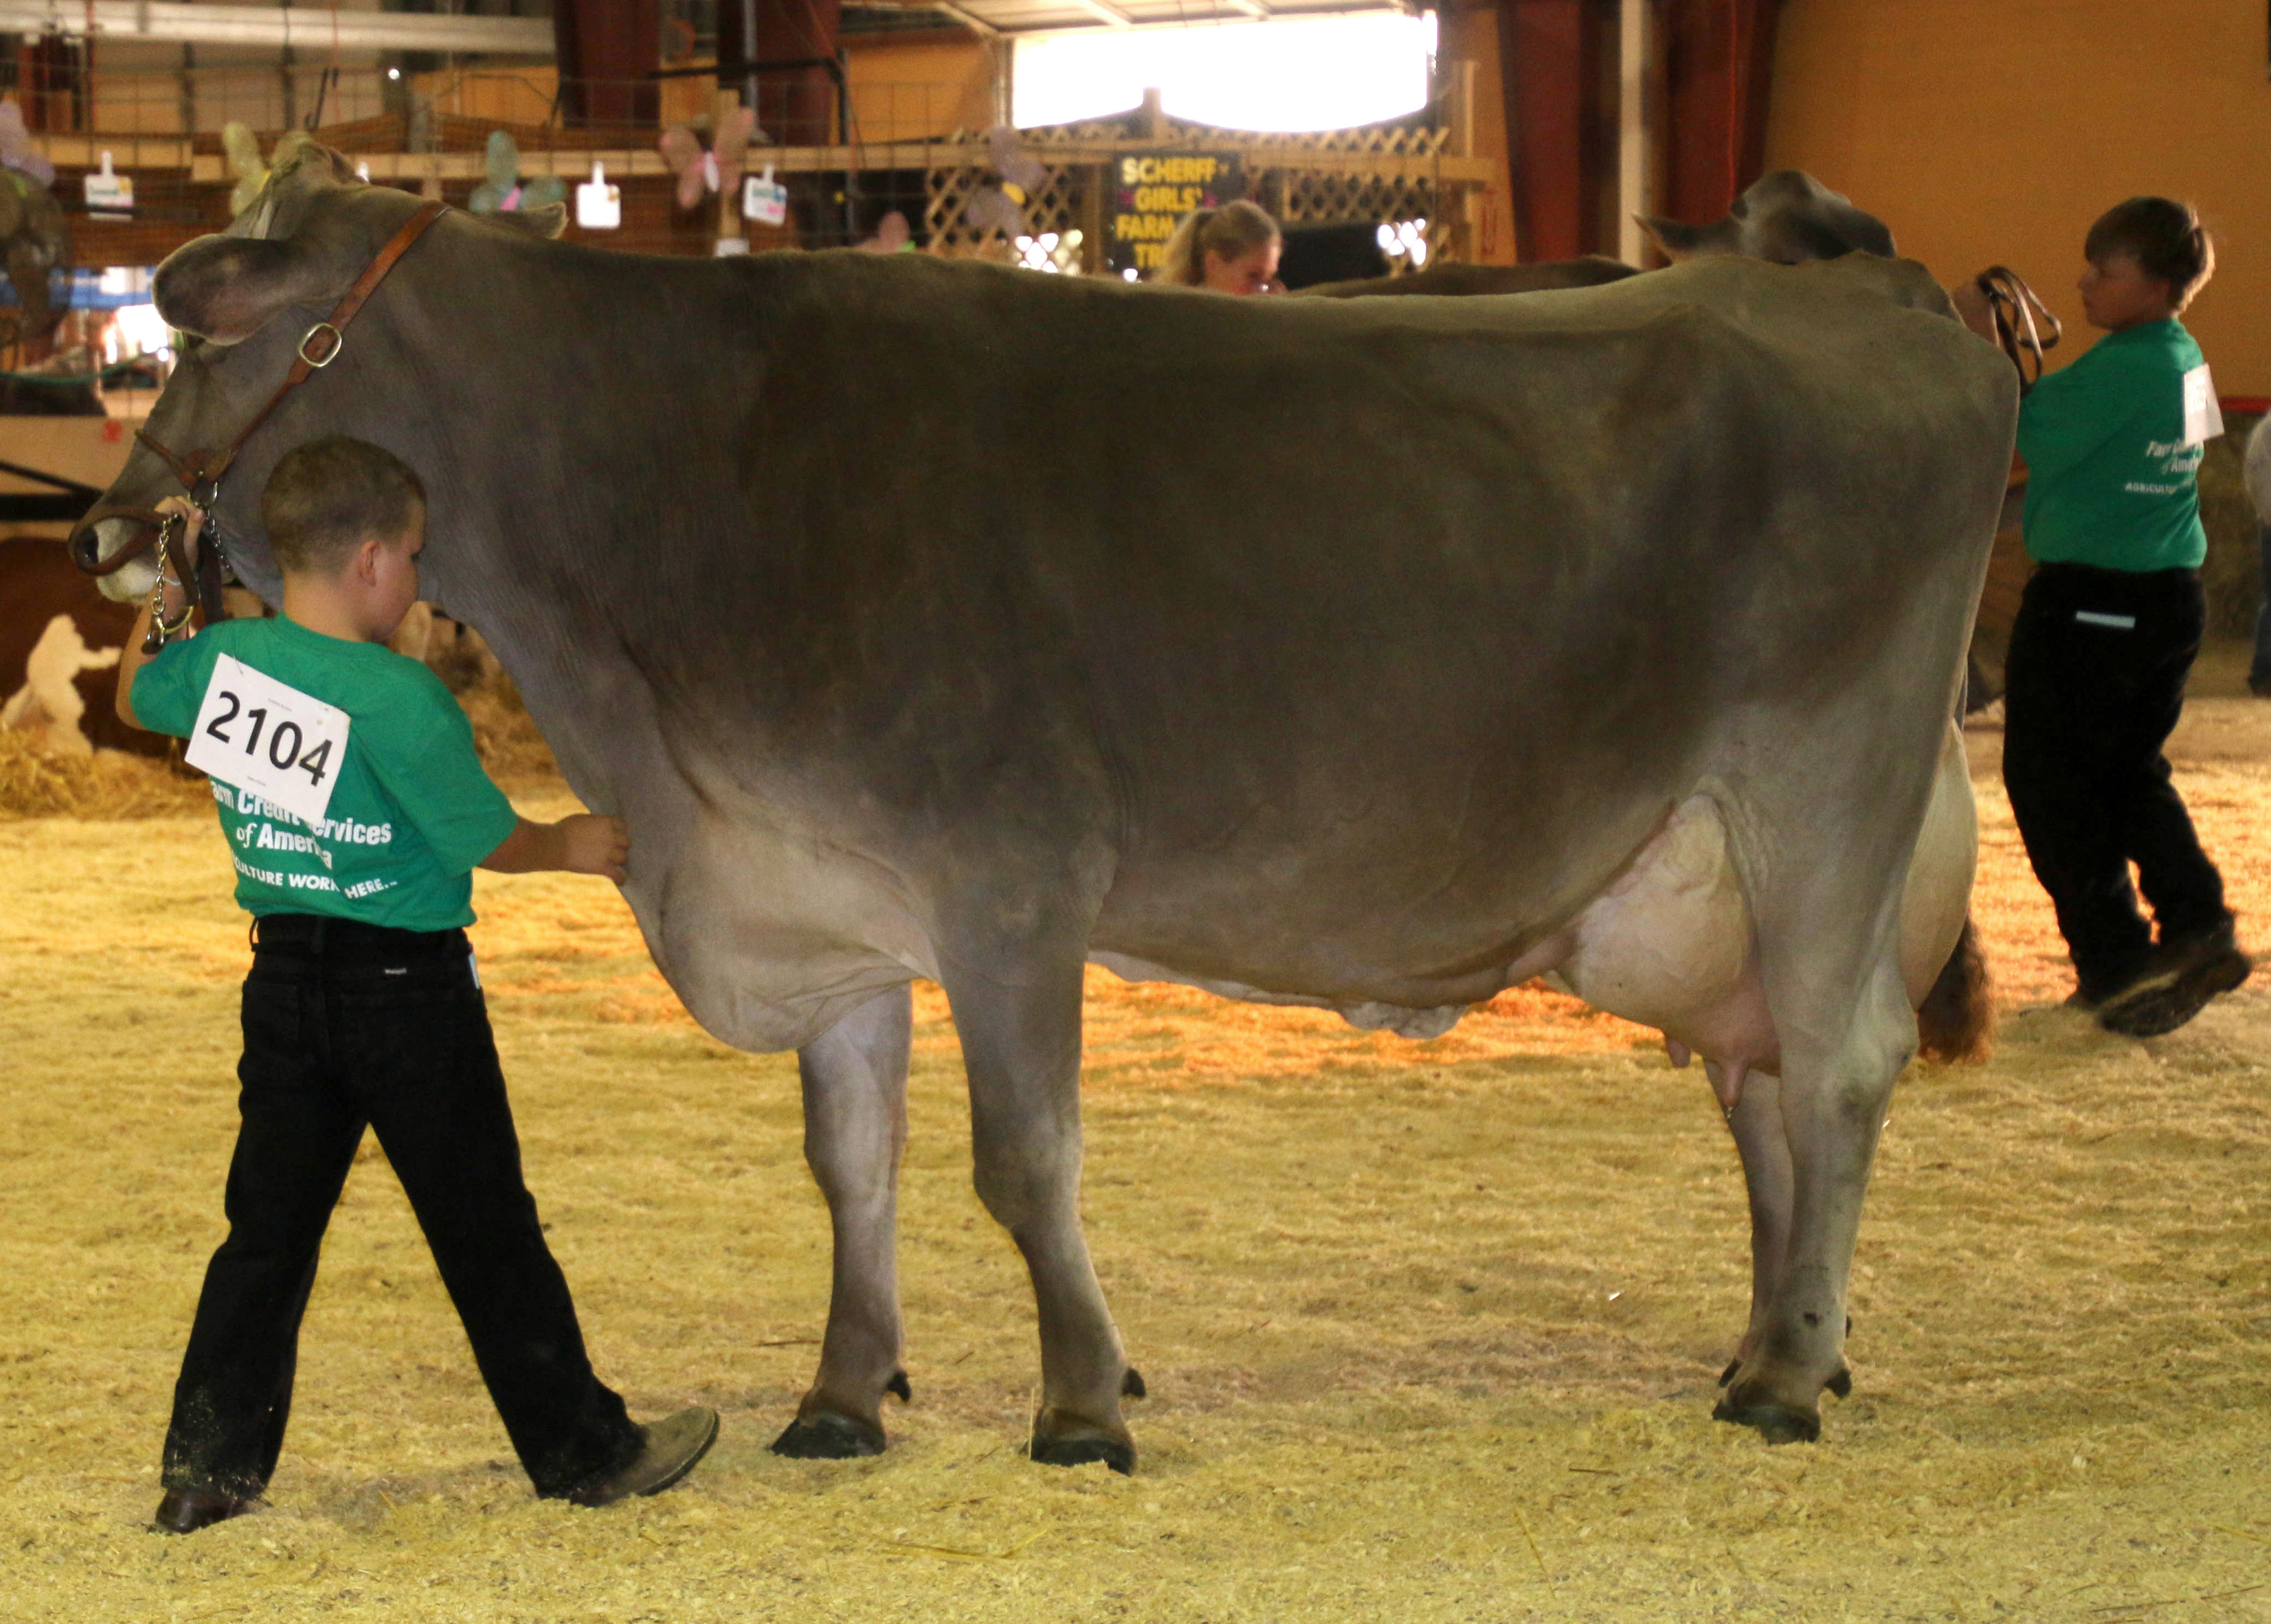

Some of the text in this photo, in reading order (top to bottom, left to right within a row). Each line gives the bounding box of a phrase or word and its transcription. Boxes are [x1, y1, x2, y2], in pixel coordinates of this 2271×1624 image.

[1123, 156, 1217, 184] SCHERFF
[1115, 214, 1175, 241] FARM
[207, 691, 332, 786] 2104
[210, 780, 235, 810] arm
[311, 817, 392, 845] ervices
[236, 823, 258, 848] of
